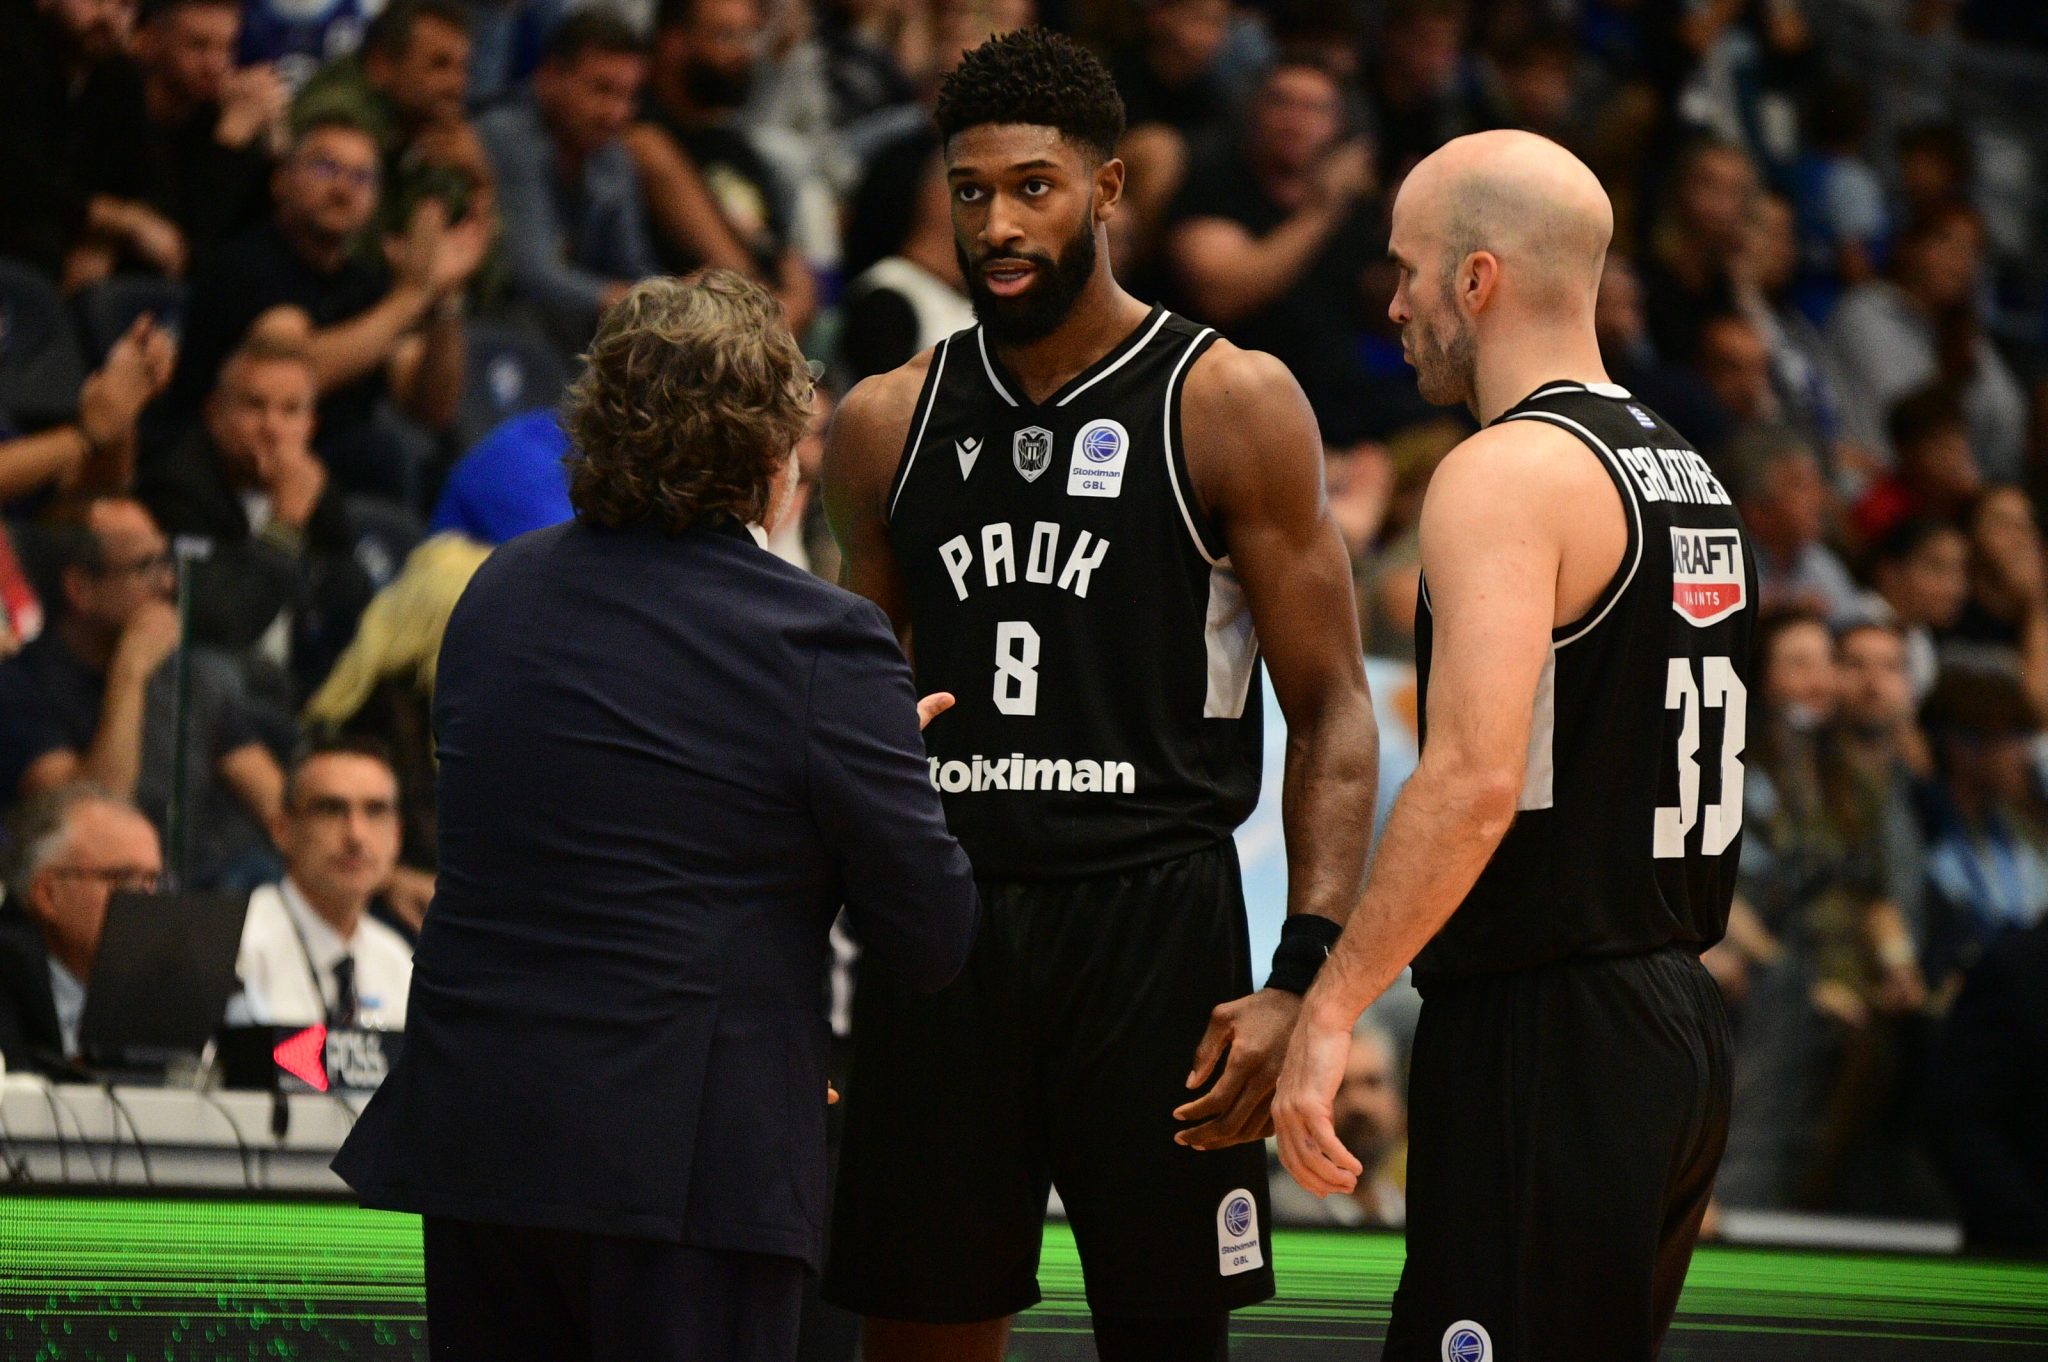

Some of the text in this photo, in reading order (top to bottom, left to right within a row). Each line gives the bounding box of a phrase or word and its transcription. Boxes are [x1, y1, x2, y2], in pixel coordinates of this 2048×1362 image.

[1072, 467, 1120, 478] Stoiximan
[1082, 481, 1106, 491] GBL
[938, 521, 1110, 601] PAOK
[1673, 534, 1738, 575] KRAFT
[993, 621, 1040, 716] 8
[927, 753, 1135, 794] toiximan
[1653, 656, 1748, 859] 33
